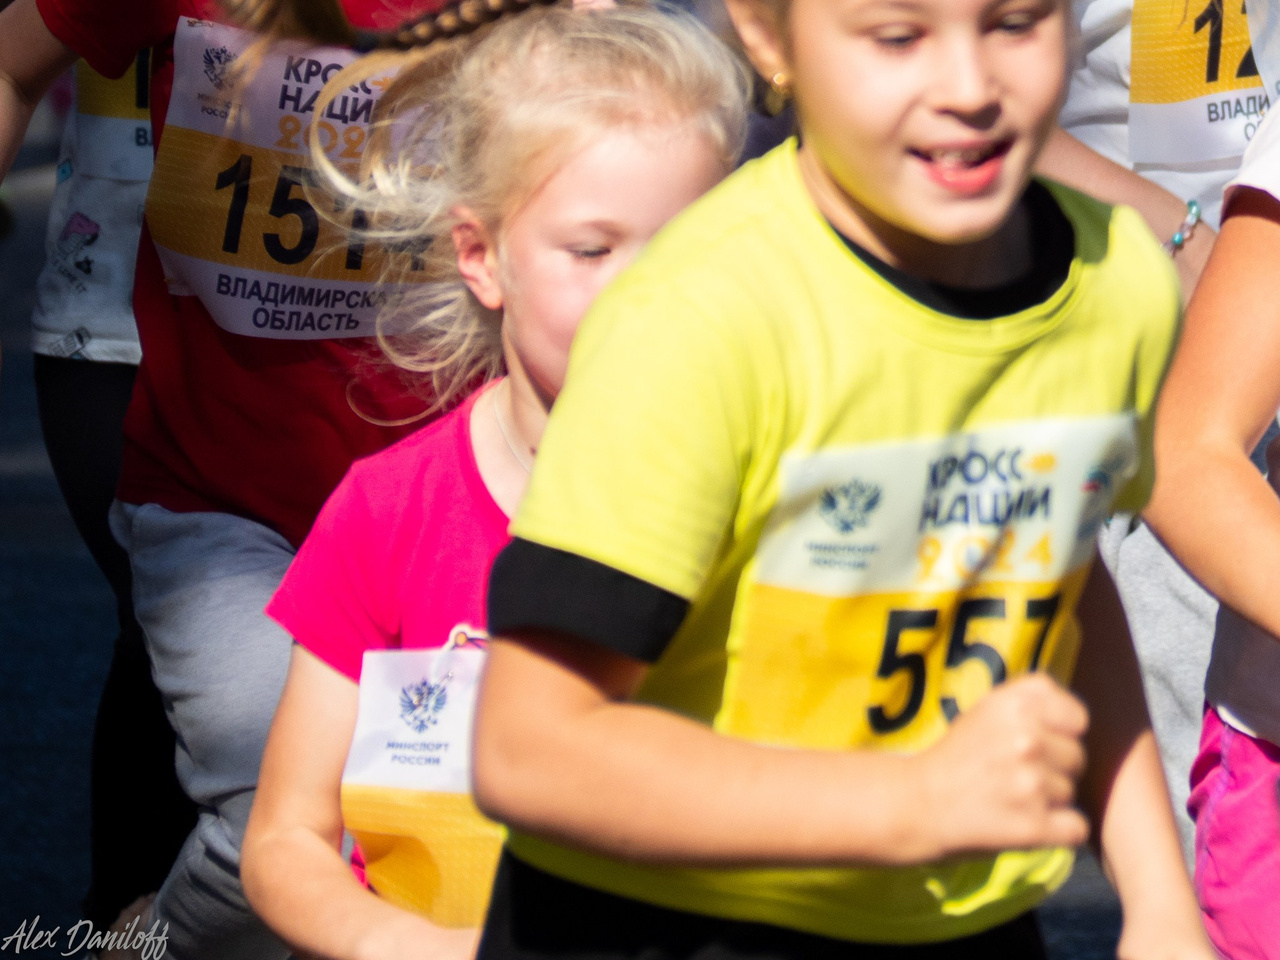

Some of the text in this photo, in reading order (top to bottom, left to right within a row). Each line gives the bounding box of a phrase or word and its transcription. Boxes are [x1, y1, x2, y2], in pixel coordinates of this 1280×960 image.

[252, 308, 360, 332] ОБЛАСТЬ
[386, 740, 449, 752] МИНСПОРТ
[391, 753, 441, 766] РОССИИ
